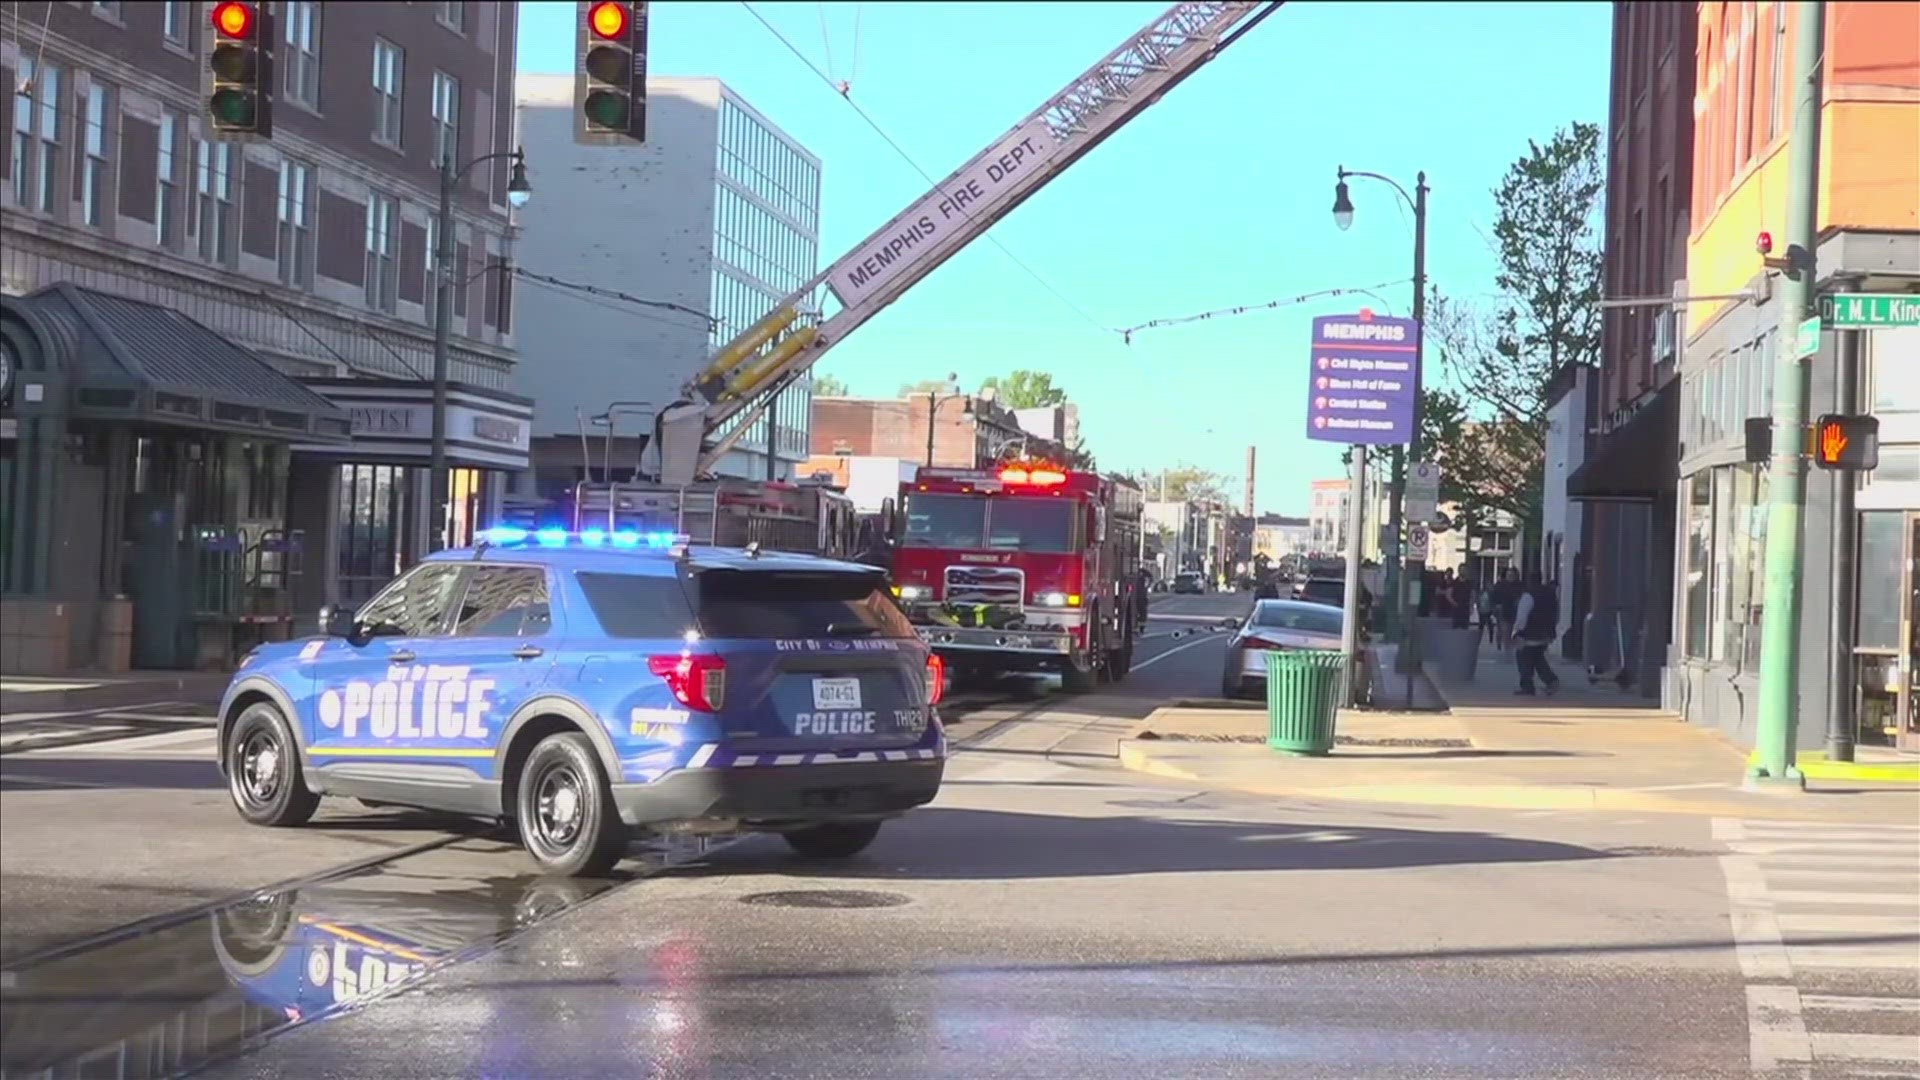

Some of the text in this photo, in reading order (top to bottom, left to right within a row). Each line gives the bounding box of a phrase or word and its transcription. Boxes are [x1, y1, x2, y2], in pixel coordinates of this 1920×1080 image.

[848, 137, 1044, 288] MEMPHIS FIRE DEPT.
[1823, 299, 1844, 321] Dr.
[1849, 299, 1866, 321] M.
[1870, 299, 1886, 321] L.
[1323, 323, 1405, 341] MEMPHIS
[775, 639, 803, 650] CITY
[343, 680, 496, 738] POLICE
[794, 711, 876, 736] POLICE
